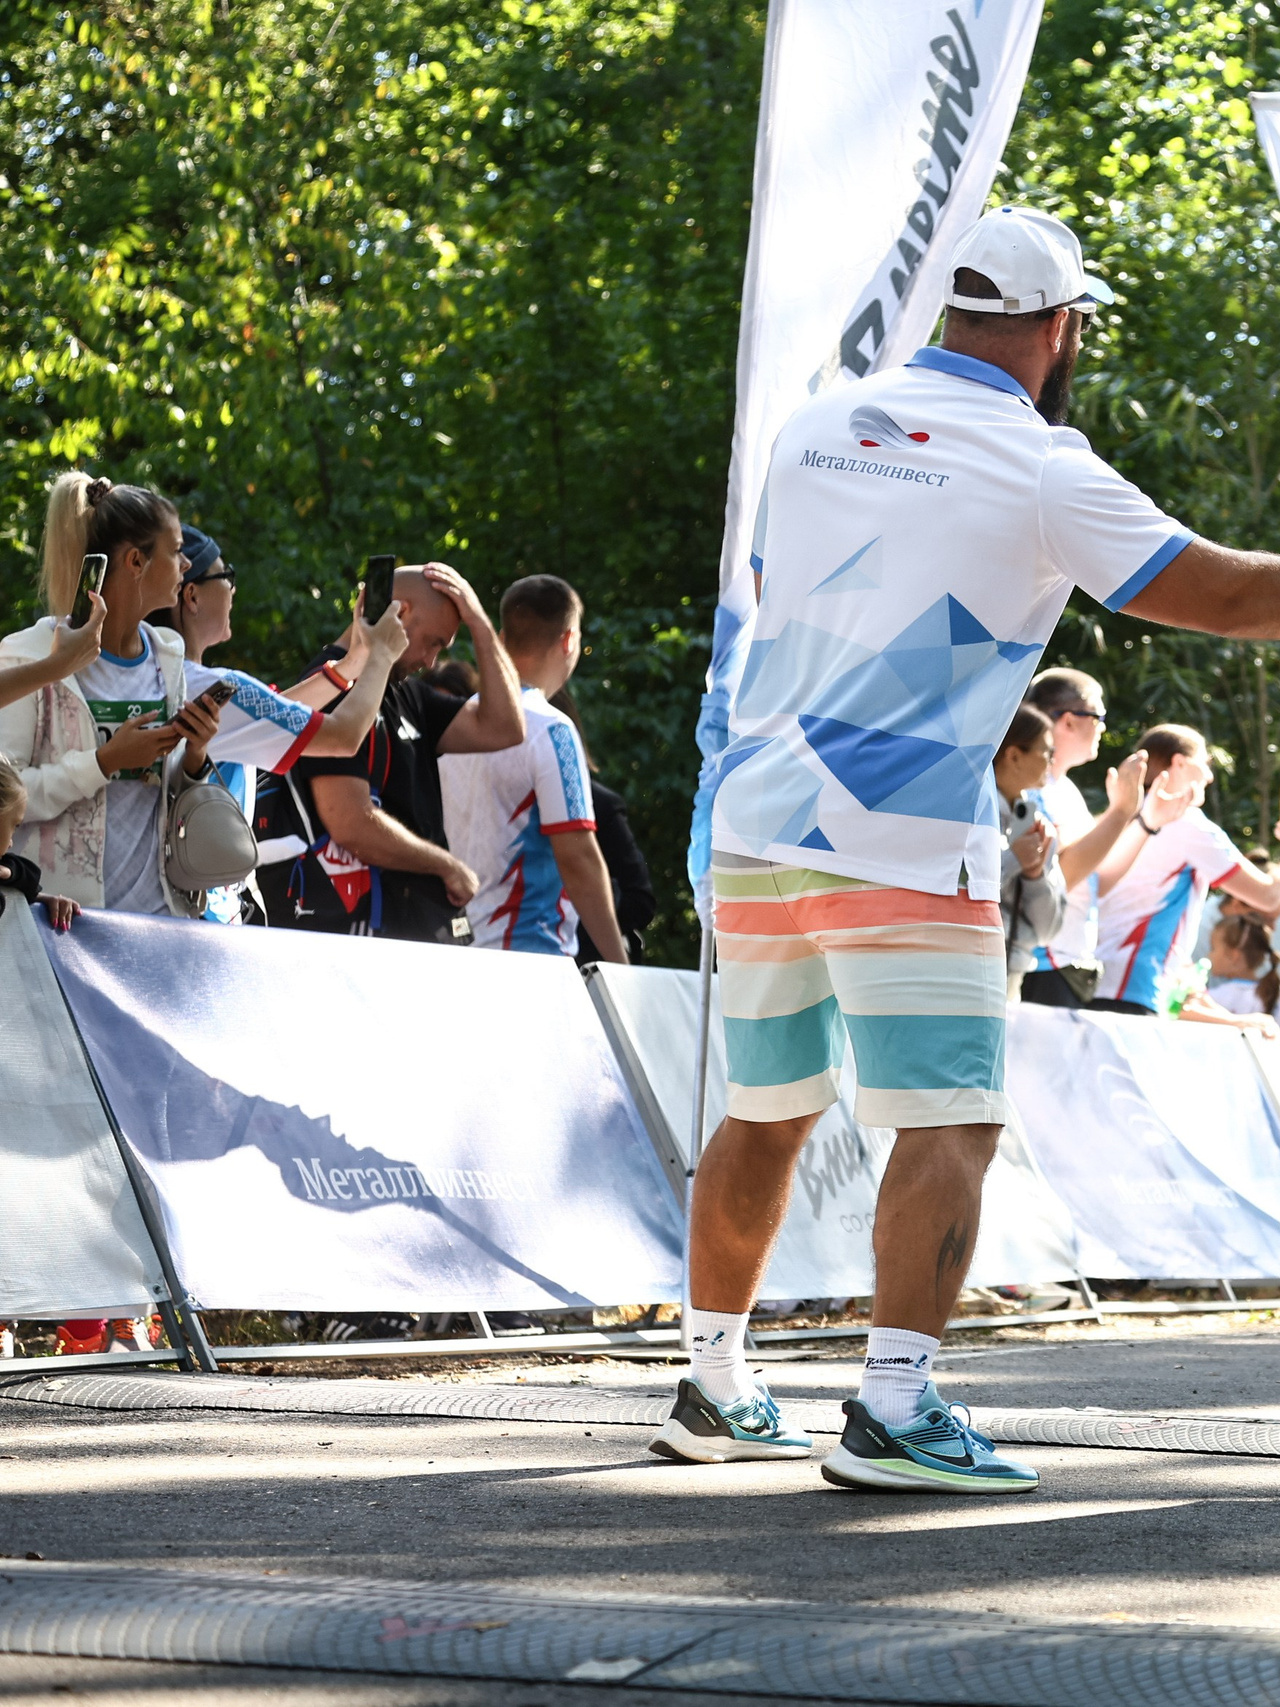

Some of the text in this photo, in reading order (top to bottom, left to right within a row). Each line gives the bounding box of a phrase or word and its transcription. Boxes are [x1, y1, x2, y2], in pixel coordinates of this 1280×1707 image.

[799, 449, 950, 488] Металлоинвест
[127, 704, 142, 719] 20
[292, 1157, 542, 1202] Металлоинвест
